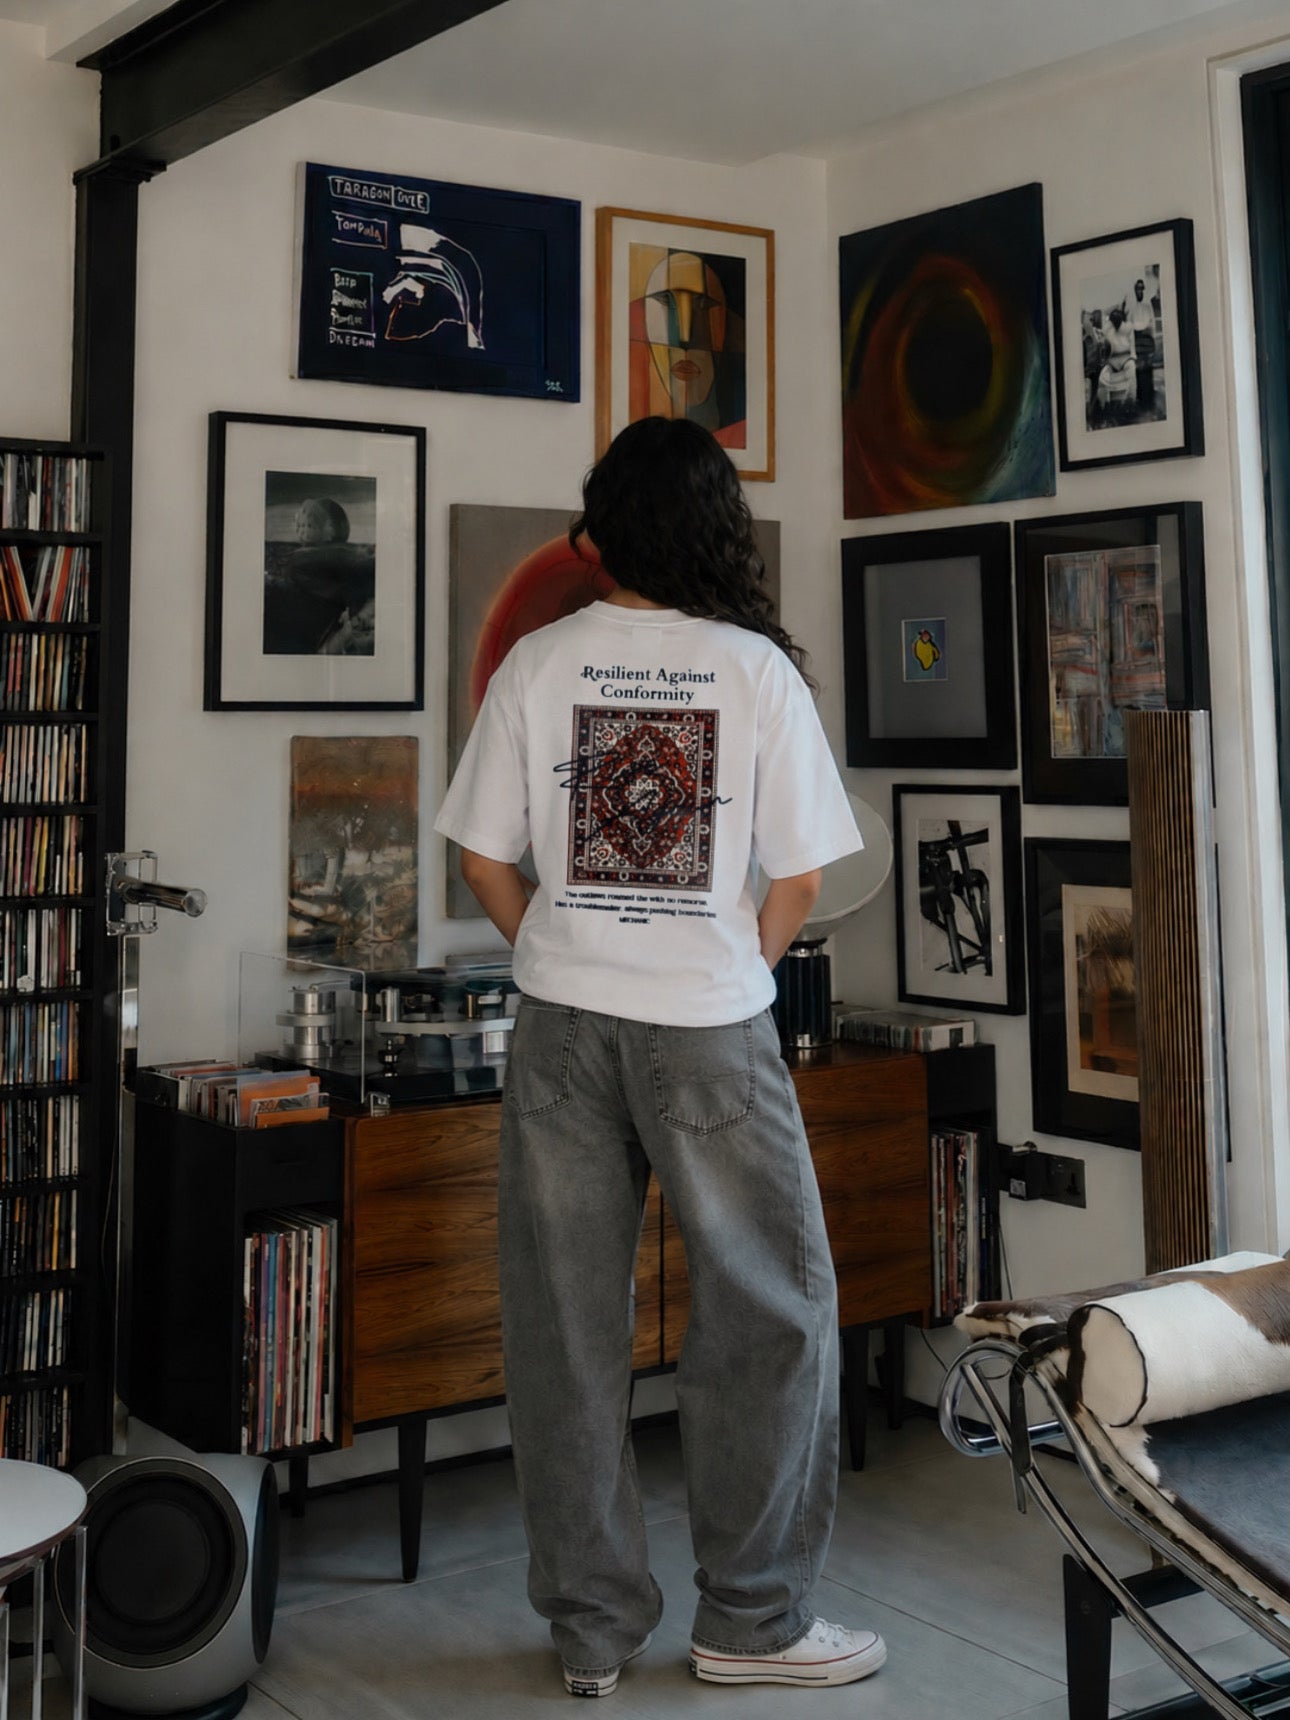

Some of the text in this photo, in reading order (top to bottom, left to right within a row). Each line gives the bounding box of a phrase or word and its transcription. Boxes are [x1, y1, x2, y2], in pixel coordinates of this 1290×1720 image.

[580, 666, 715, 685] Resilient Against
[601, 684, 694, 705] Conformity
[565, 890, 578, 898] The
